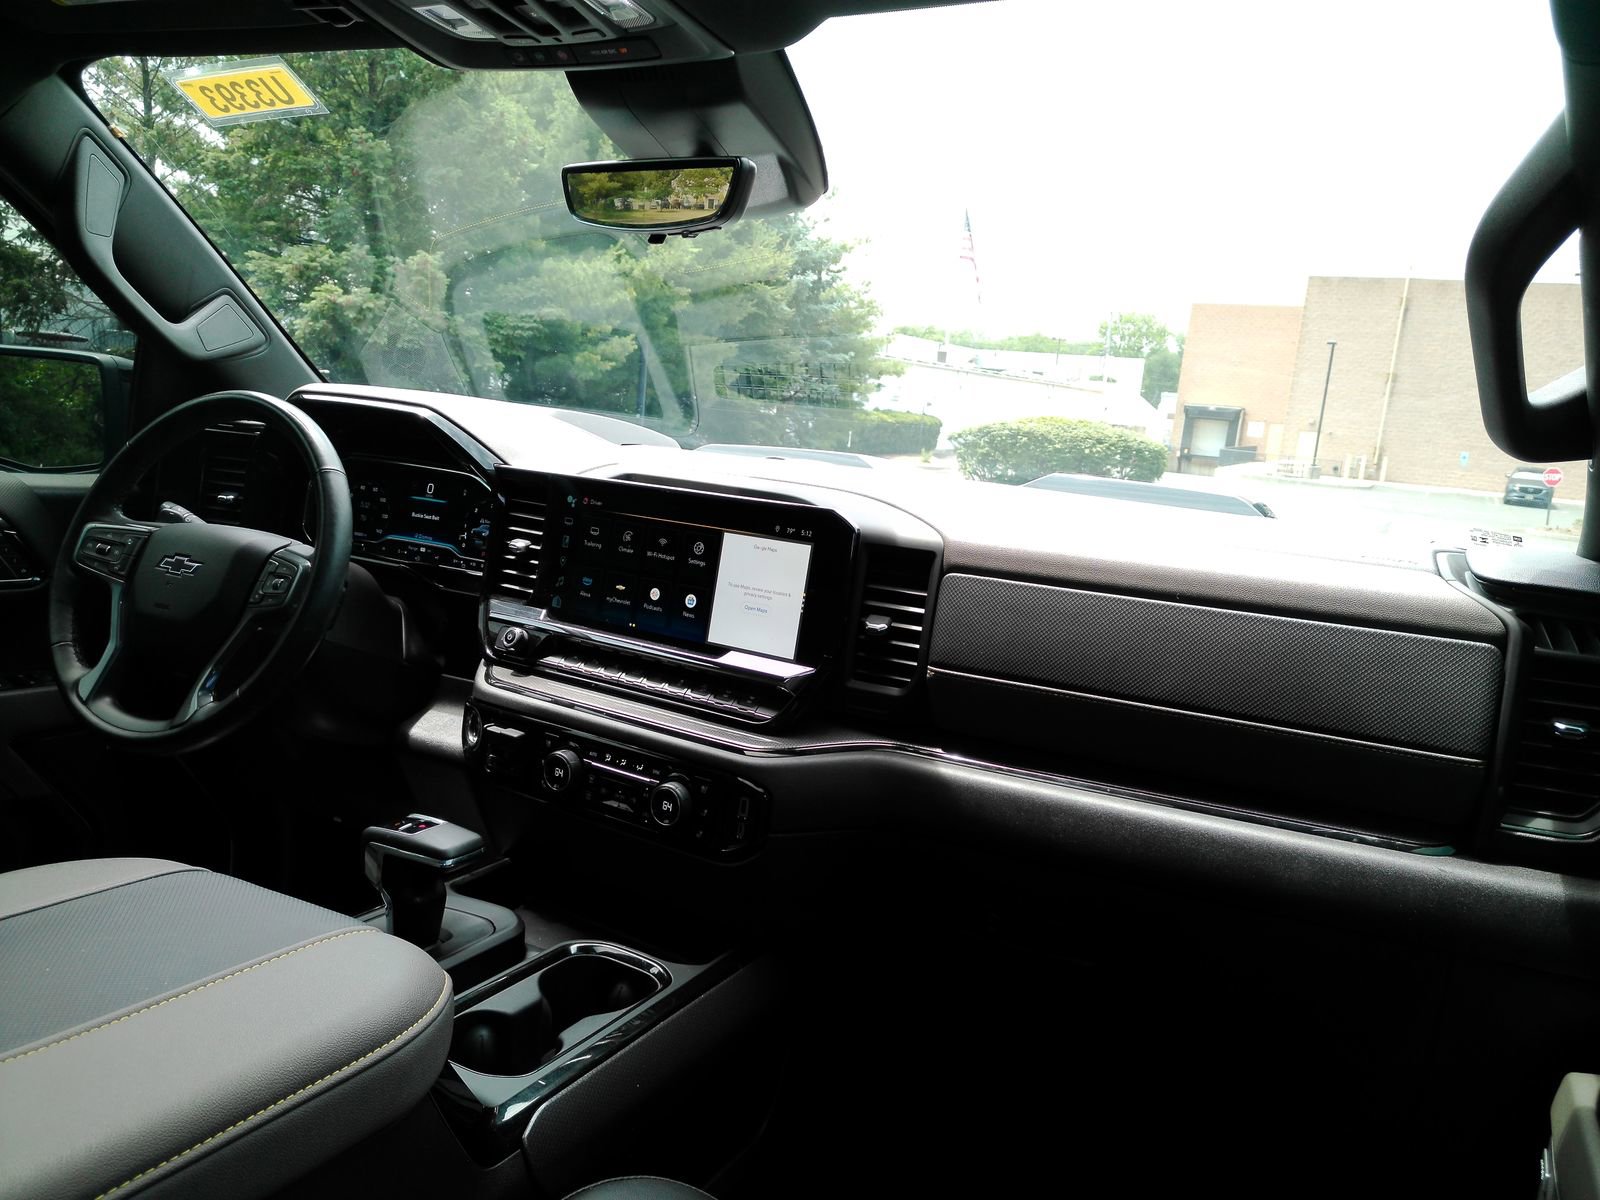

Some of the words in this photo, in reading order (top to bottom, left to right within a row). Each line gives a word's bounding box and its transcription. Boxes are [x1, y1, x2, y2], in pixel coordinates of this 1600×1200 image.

[427, 483, 434, 494] 0
[618, 545, 634, 554] Climate
[659, 553, 675, 561] Hotspot
[688, 558, 706, 567] Settings
[606, 596, 631, 605] myChevrolet
[643, 603, 662, 612] Podcasts
[683, 611, 695, 619] News
[554, 767, 564, 778] 64
[662, 800, 672, 812] 64
